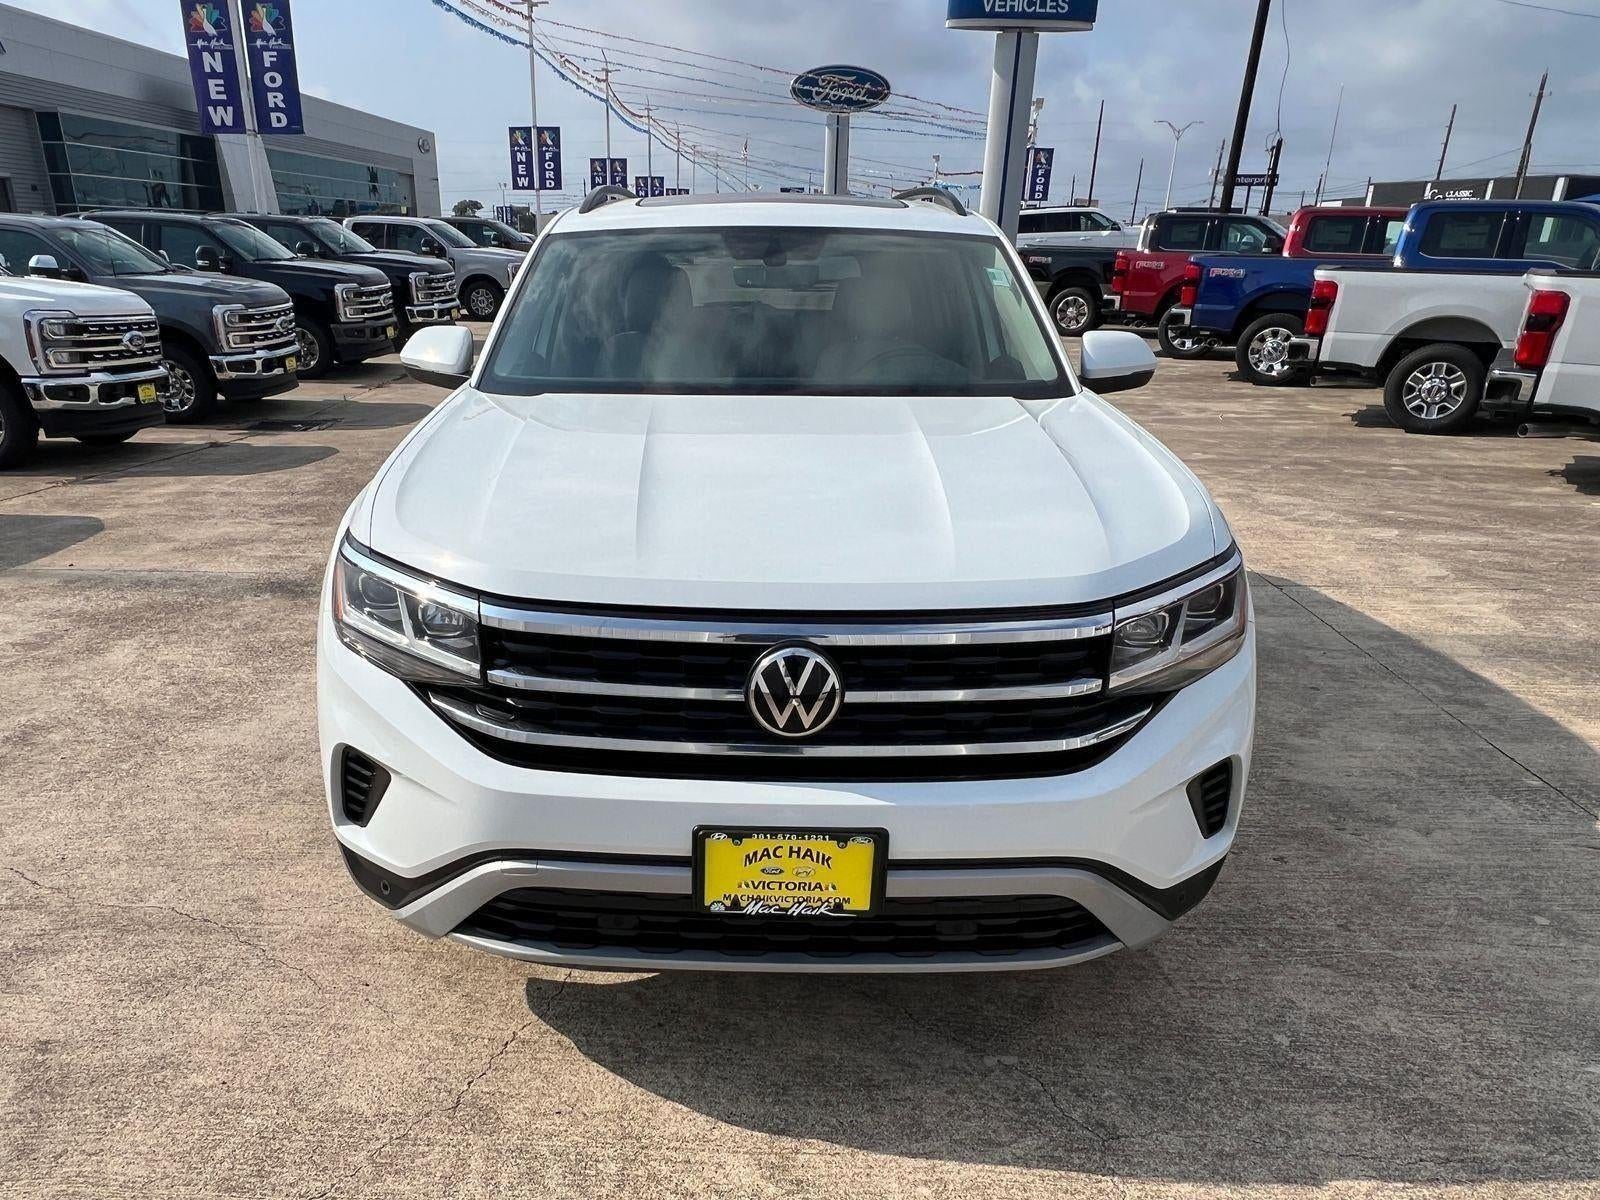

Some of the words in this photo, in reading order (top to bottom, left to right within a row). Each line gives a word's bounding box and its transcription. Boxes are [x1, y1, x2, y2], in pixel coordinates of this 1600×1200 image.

[983, 0, 1069, 13] VEHICLES
[201, 51, 234, 127] NEW
[262, 51, 288, 128] FORD
[812, 74, 870, 101] Ford
[516, 151, 529, 187] NEW
[544, 151, 555, 188] FORD
[1034, 169, 1046, 200] FORD
[743, 845, 784, 868] MAC
[788, 845, 833, 869] HAIK
[750, 880, 824, 892] VICTORIA
[742, 899, 784, 915] Mac
[786, 901, 834, 916] Haik
